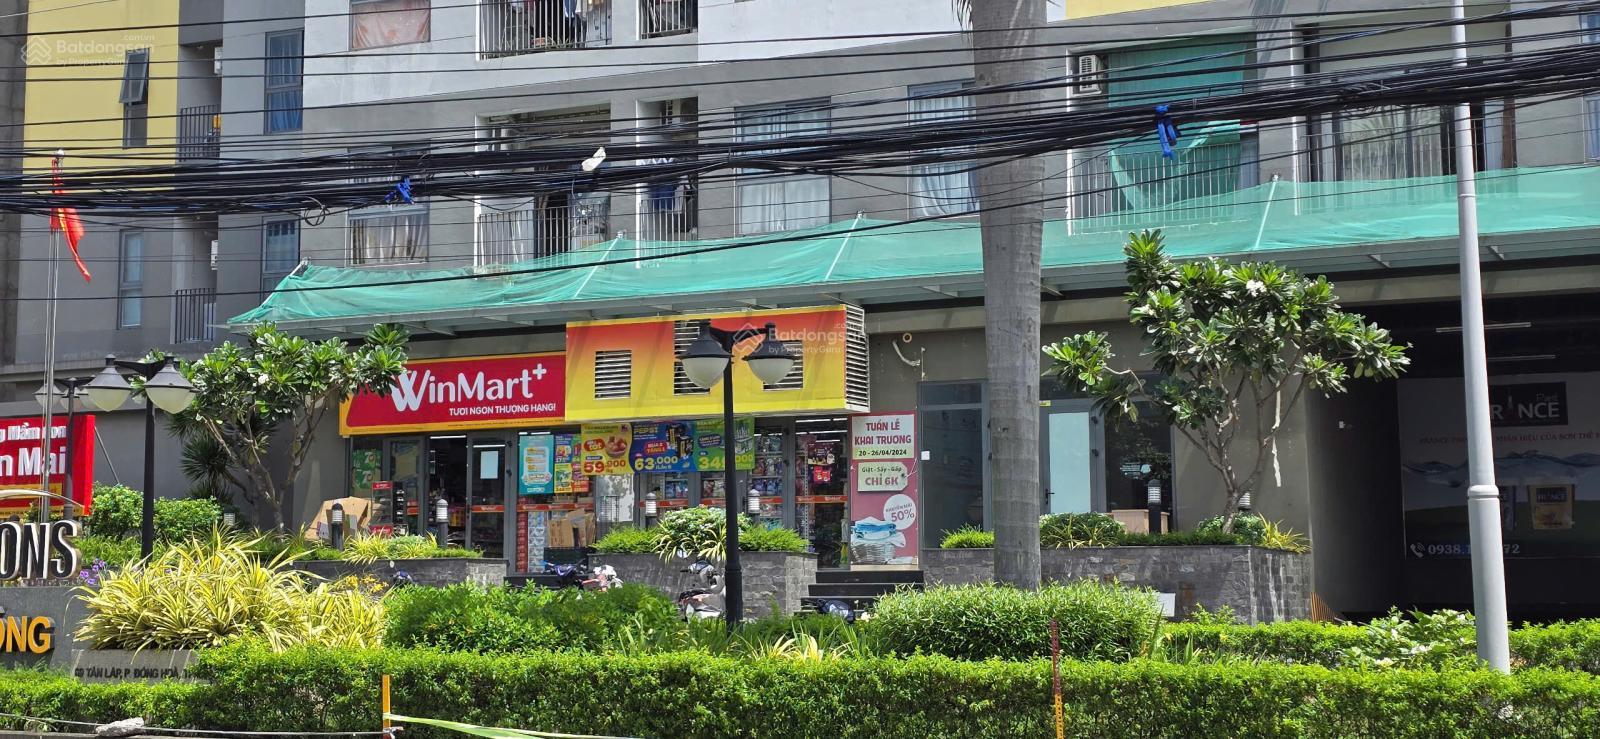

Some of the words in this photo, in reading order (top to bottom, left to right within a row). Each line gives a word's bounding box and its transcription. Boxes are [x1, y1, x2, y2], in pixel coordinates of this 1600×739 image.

[390, 363, 547, 412] WinMart+
[470, 405, 495, 415] NGON
[531, 402, 557, 413] HẠNG!
[855, 436, 874, 445] KHAI
[18, 446, 67, 476] Mai
[865, 473, 883, 485] CHỈ
[884, 476, 899, 485] 6K
[891, 508, 915, 522] 50%
[86, 666, 103, 678] TÂN
